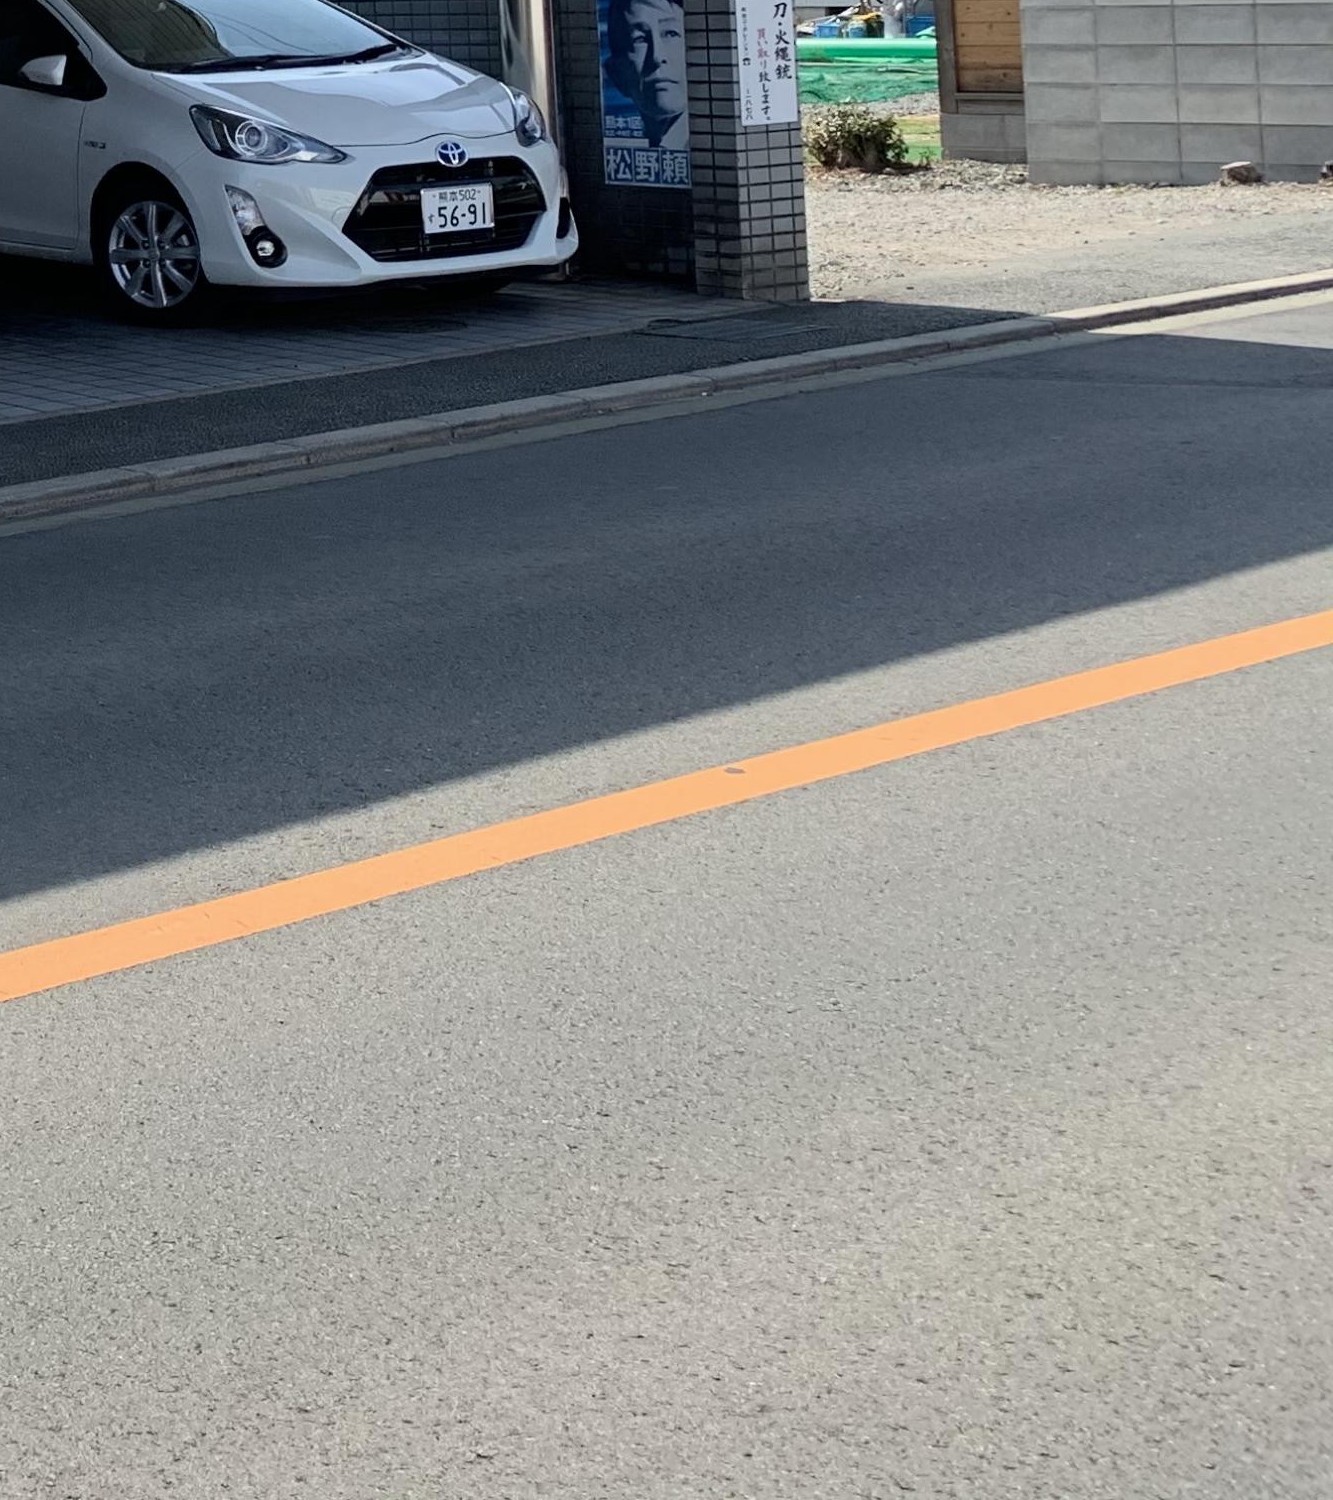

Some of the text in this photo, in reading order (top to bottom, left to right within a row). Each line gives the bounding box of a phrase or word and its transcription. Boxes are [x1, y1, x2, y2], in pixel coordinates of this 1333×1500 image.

[772, 2, 793, 80] 刀・火縄銃
[607, 148, 689, 183] 松野頼
[437, 201, 487, 229] 56-91
